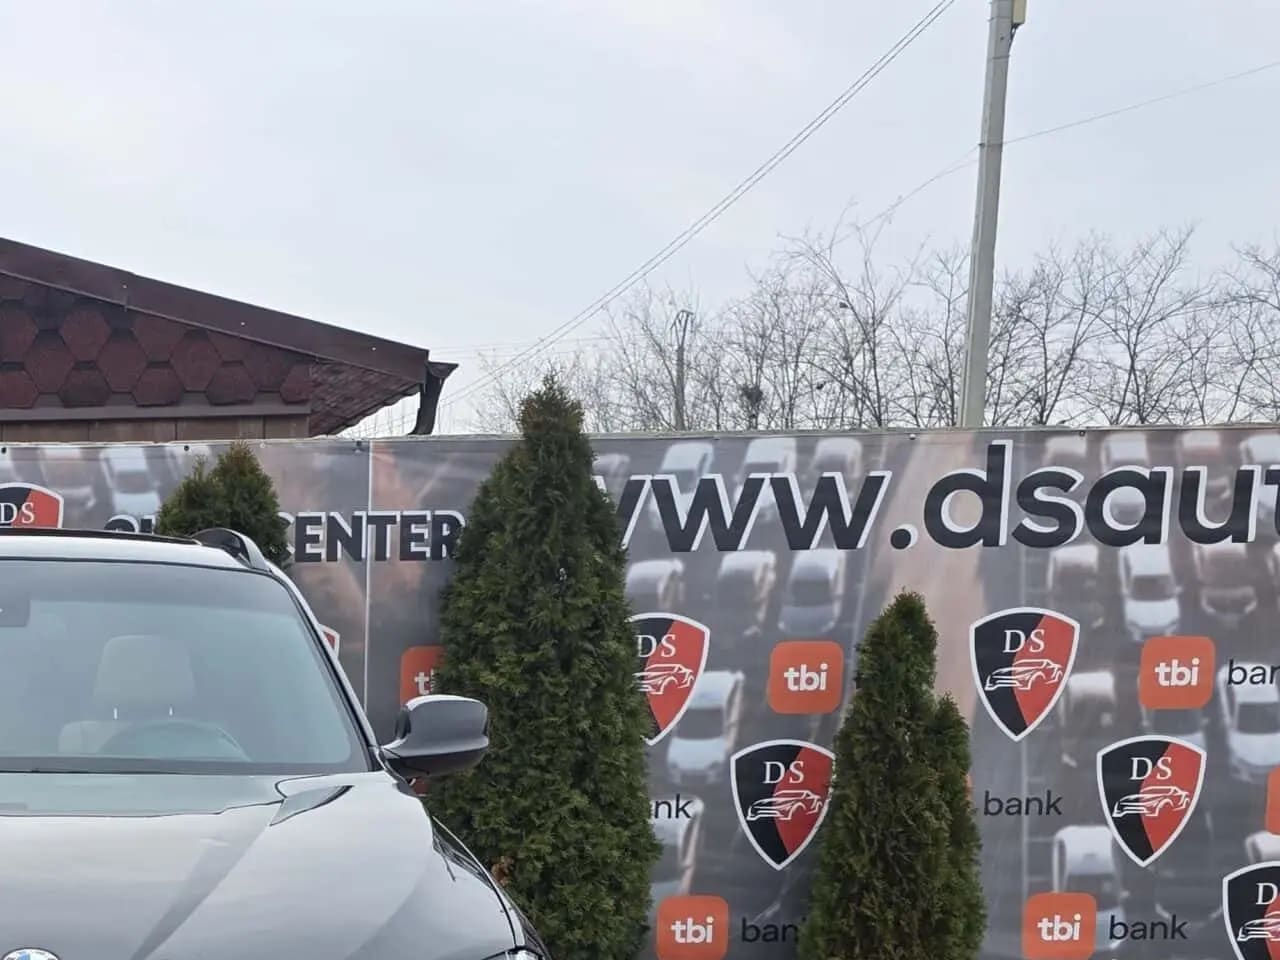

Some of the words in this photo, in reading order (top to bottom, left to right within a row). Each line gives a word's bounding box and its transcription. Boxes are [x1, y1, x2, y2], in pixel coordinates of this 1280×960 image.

[0, 502, 35, 524] DS
[637, 633, 676, 657] DS
[1003, 629, 1045, 654] DS
[783, 663, 828, 692] tbi
[1155, 658, 1201, 687] tbi
[763, 760, 805, 784] DS
[1130, 756, 1173, 781] DS
[983, 789, 1063, 817] bank
[670, 915, 715, 944] tbi
[741, 916, 807, 944] ban
[1037, 913, 1081, 941] tbi
[1108, 914, 1188, 941] bank
